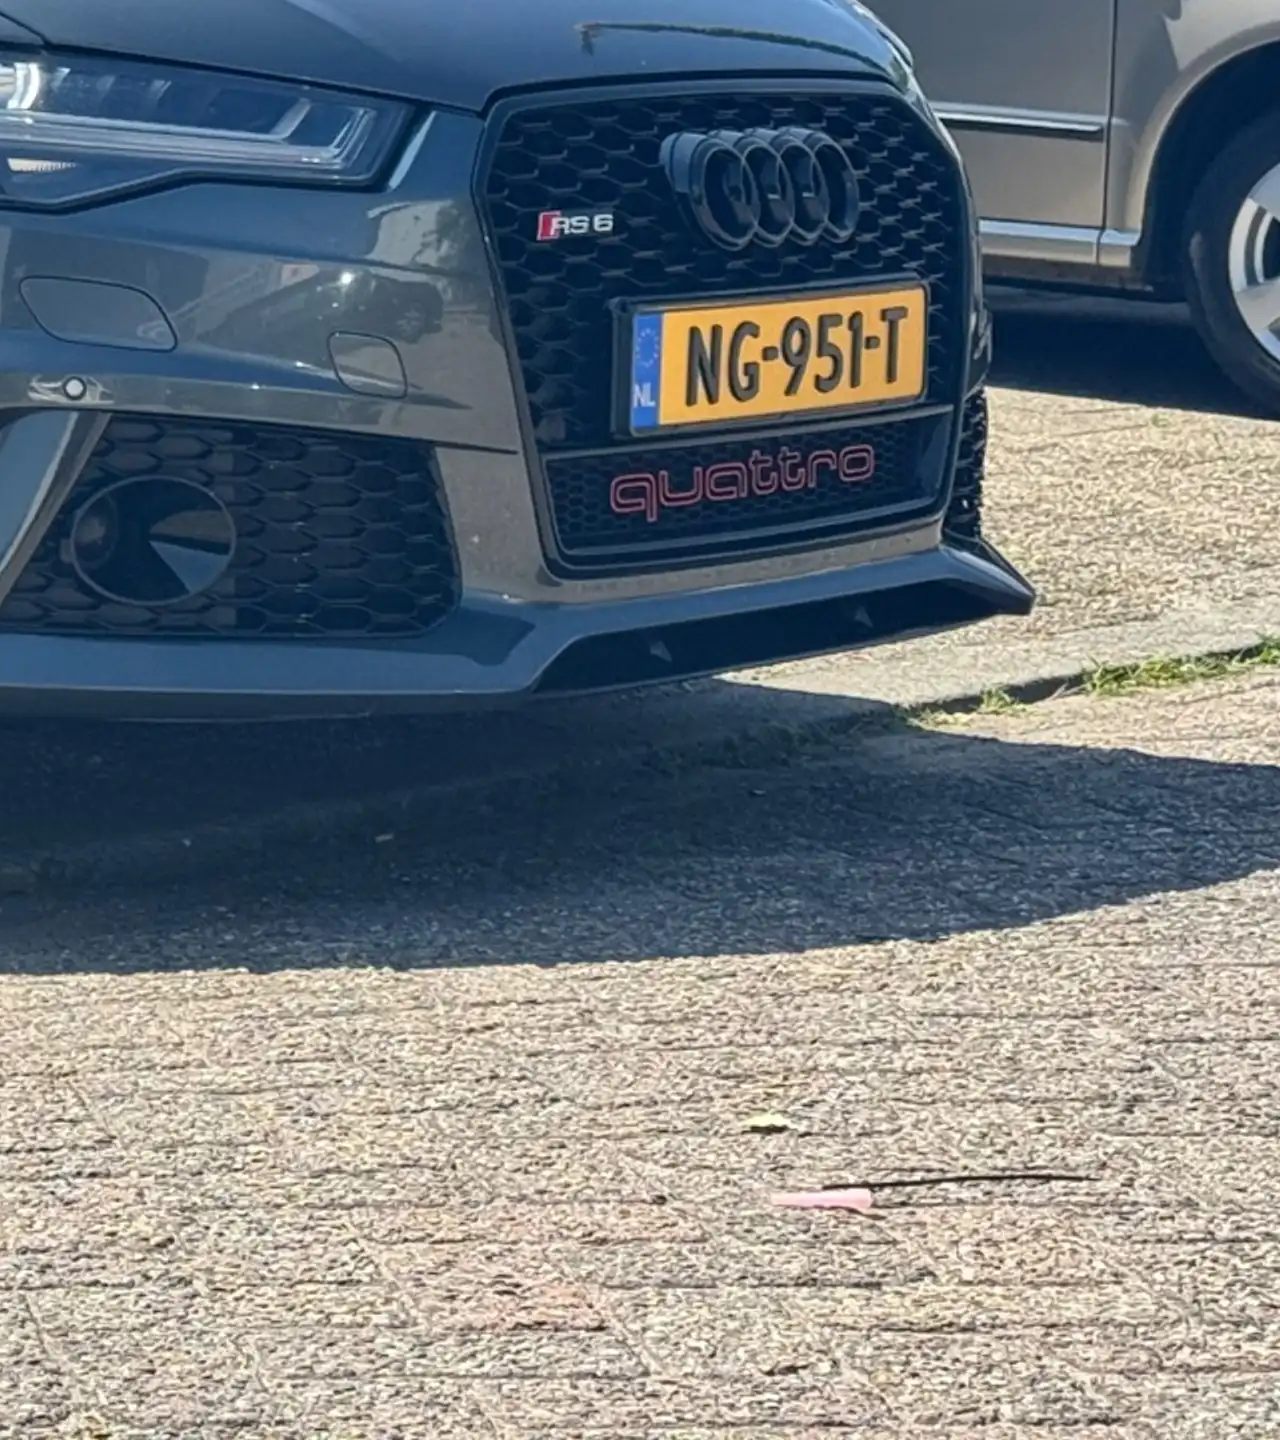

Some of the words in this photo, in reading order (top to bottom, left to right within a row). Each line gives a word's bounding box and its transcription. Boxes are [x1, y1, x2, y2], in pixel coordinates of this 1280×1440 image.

[632, 382, 656, 408] NL
[686, 306, 908, 407] NG-951-T
[610, 444, 875, 523] quattro
